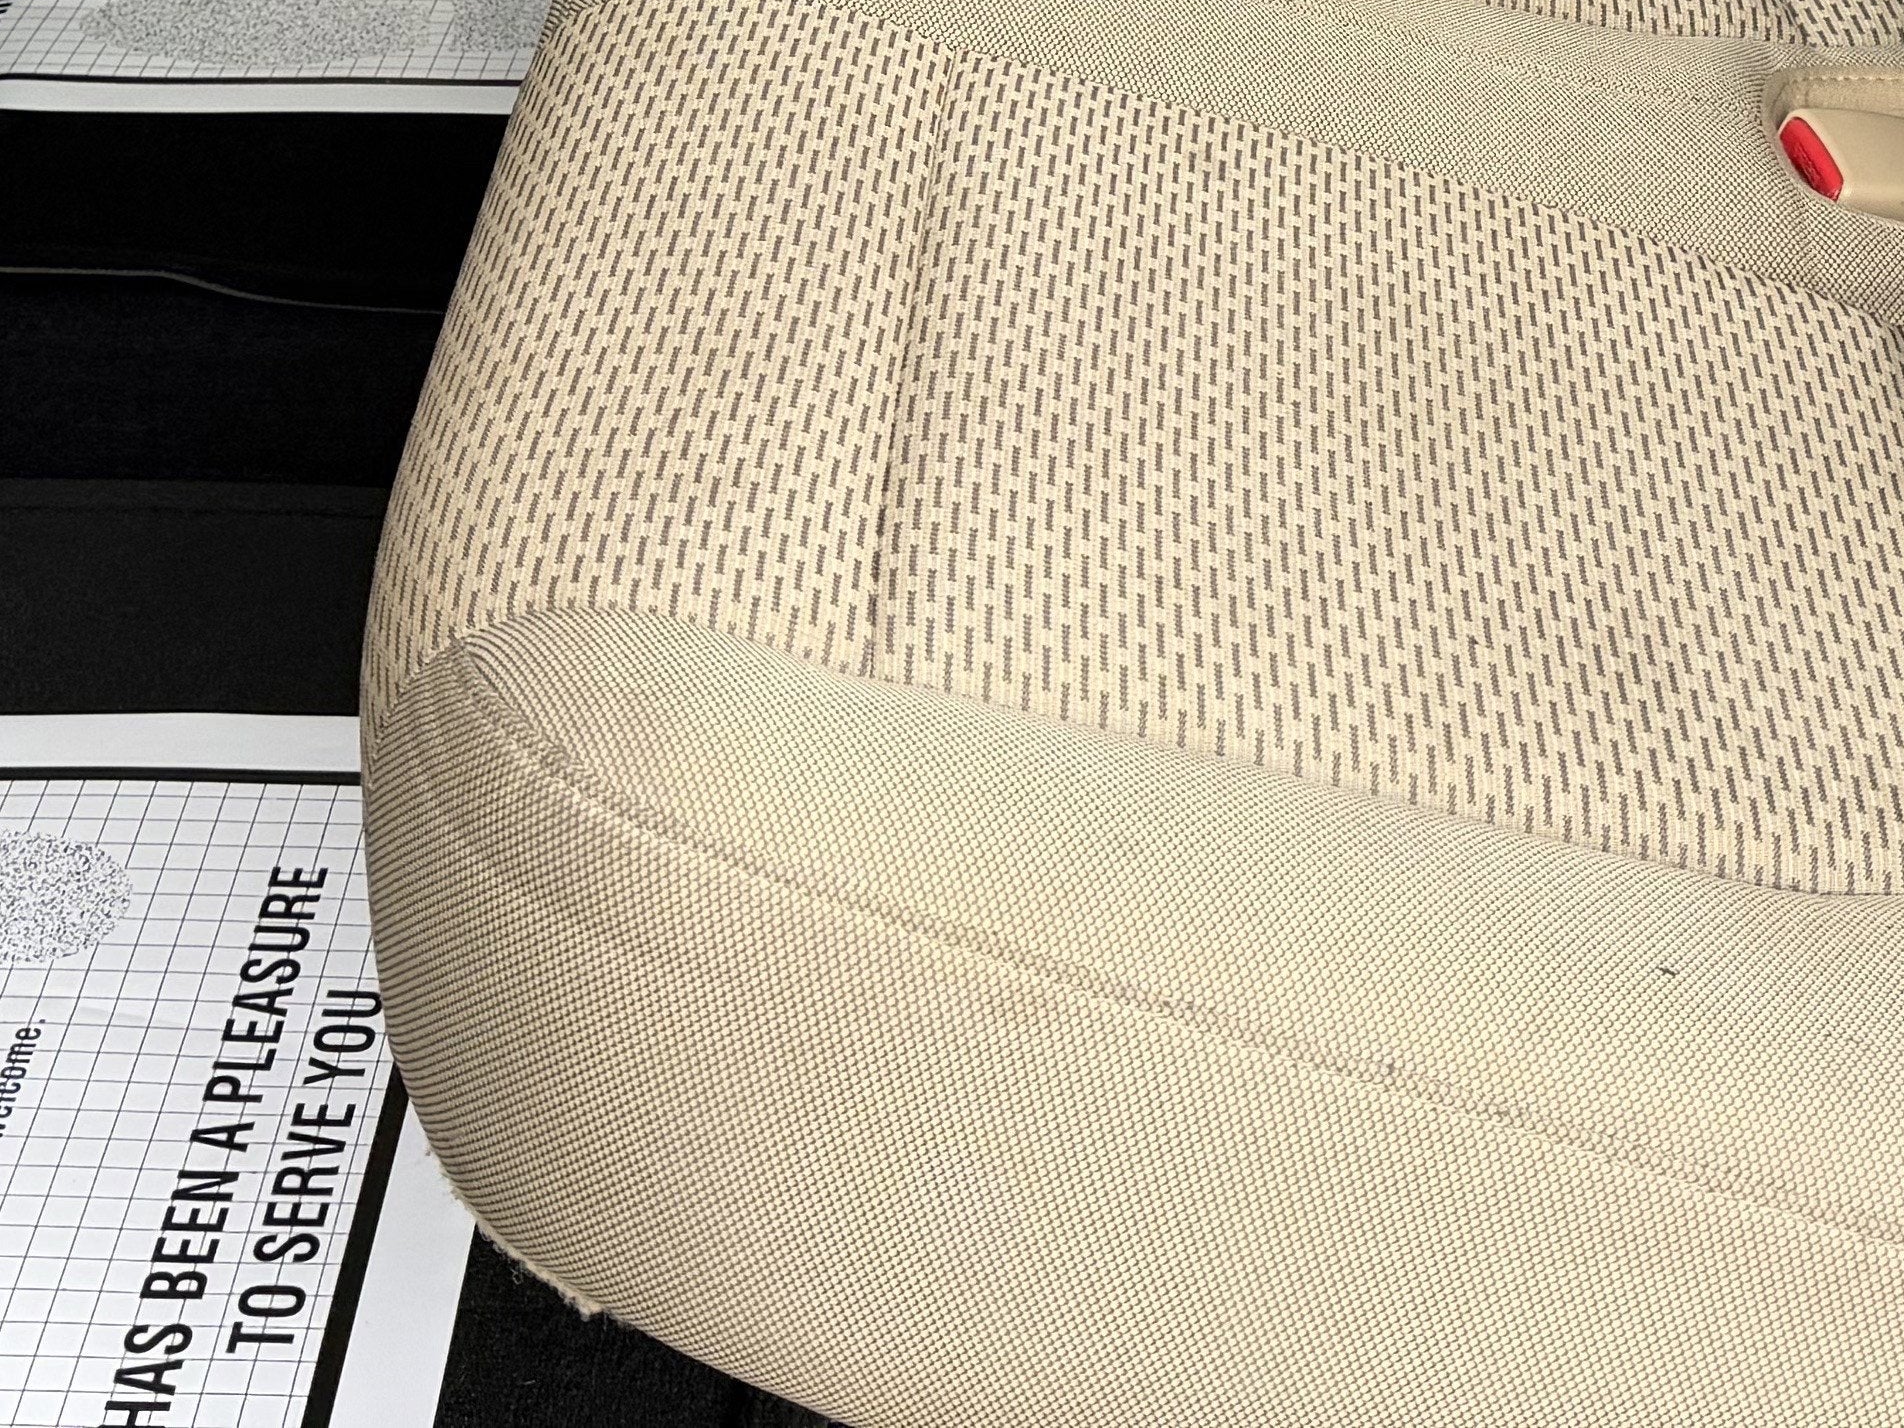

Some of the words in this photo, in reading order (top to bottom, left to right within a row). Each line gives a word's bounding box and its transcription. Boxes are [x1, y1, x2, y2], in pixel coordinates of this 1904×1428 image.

[202, 865, 329, 1104] PLEASURE
[302, 989, 383, 1088] YOU
[190, 1120, 256, 1152] A
[253, 1102, 357, 1263] SERVE
[140, 1169, 239, 1300] BEEN
[225, 1285, 306, 1353] TO
[96, 1323, 193, 1428] HAS
